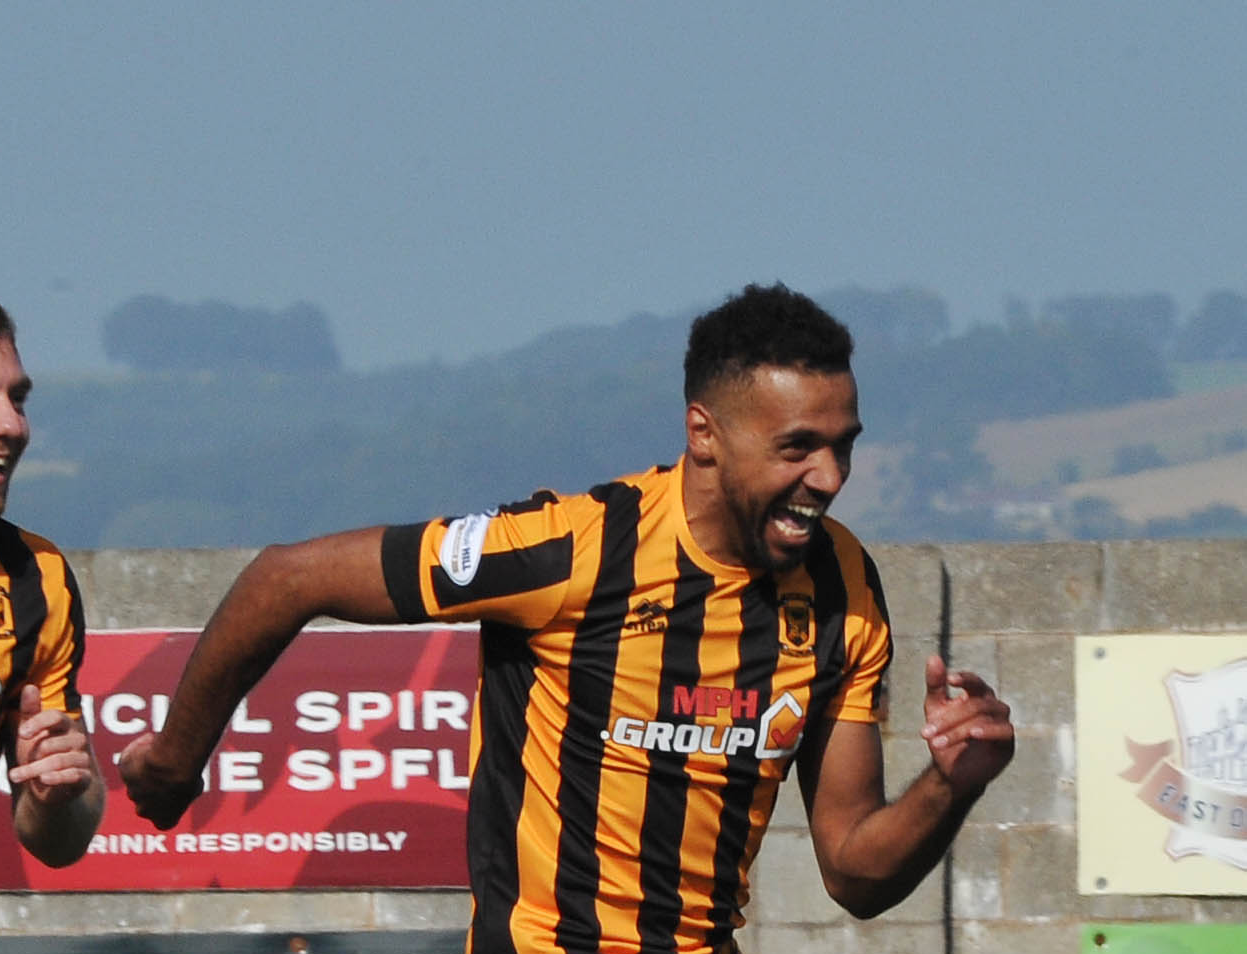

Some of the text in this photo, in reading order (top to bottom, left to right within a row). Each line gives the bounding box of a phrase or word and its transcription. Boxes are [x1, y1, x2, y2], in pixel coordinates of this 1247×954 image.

[295, 691, 470, 733] SPIR
[673, 685, 759, 719] MPH
[287, 749, 471, 791] SPFL
[87, 831, 408, 854] RINK RESPONSIBLY
